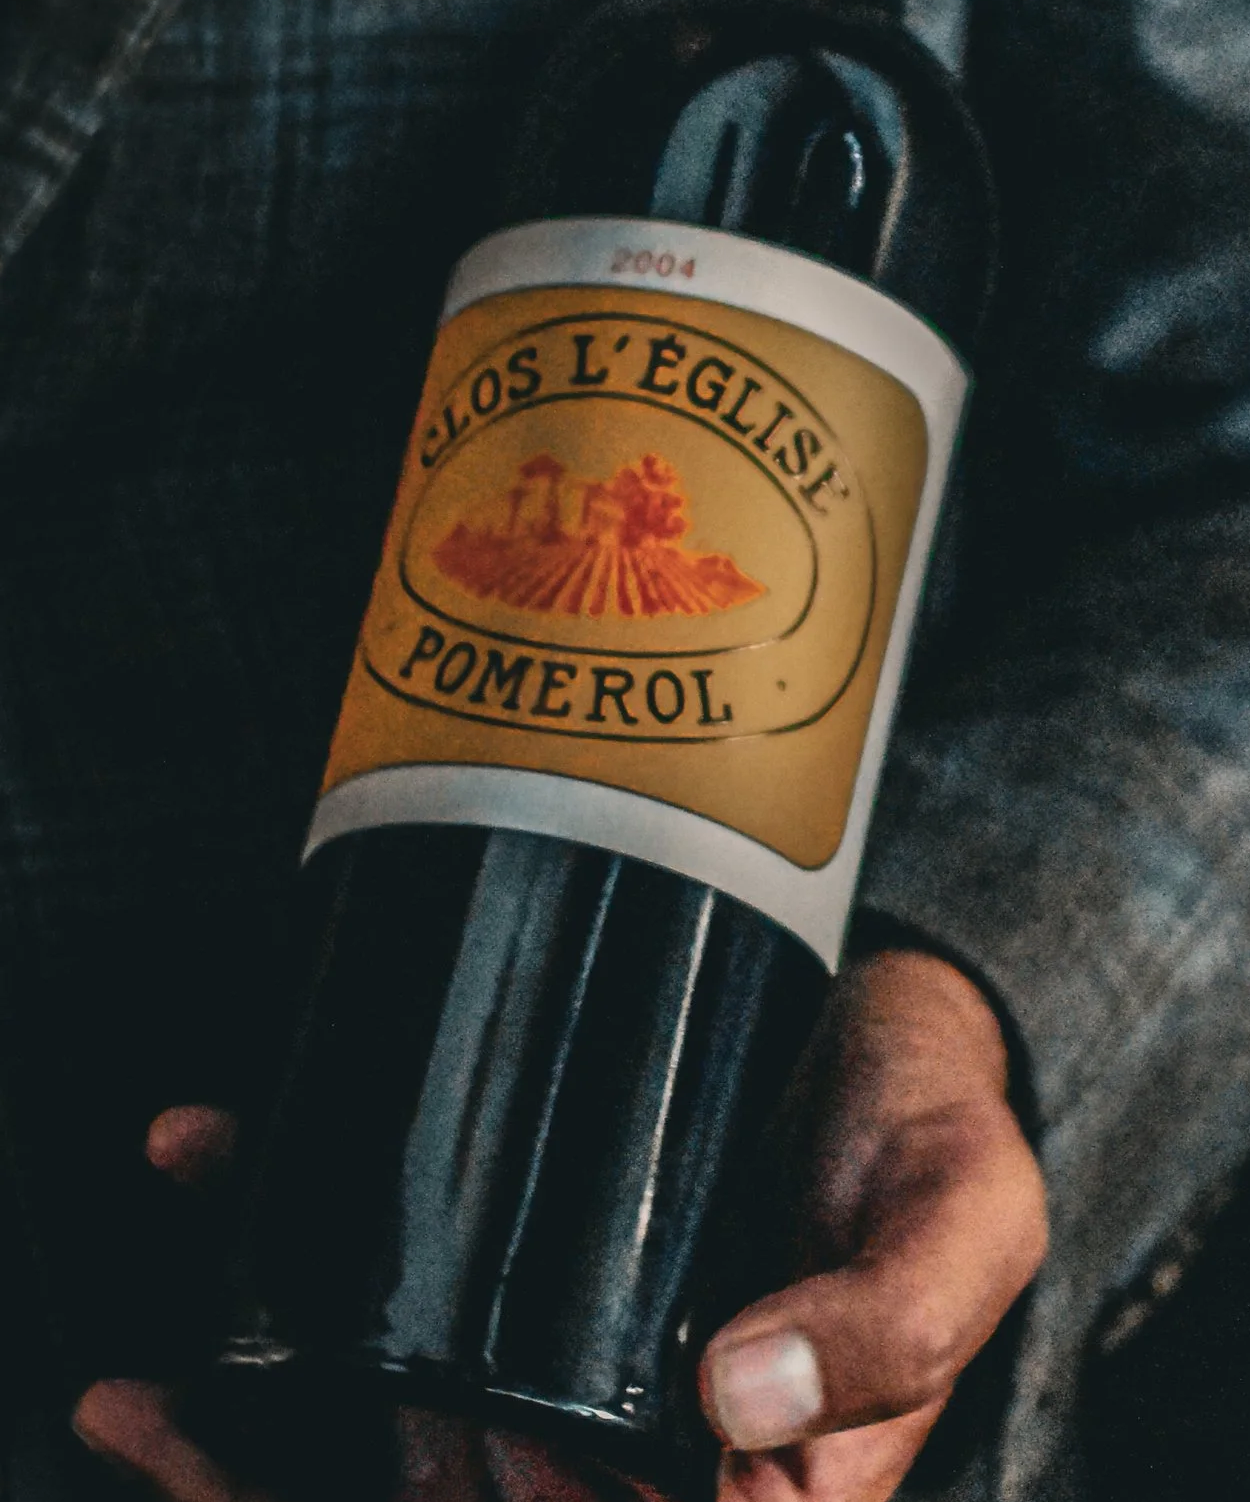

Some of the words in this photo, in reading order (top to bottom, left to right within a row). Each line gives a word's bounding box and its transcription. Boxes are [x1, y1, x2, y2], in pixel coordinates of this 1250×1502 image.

[610, 245, 697, 281] 2004
[420, 347, 542, 468] CLOS
[399, 625, 733, 725] POMEROL
